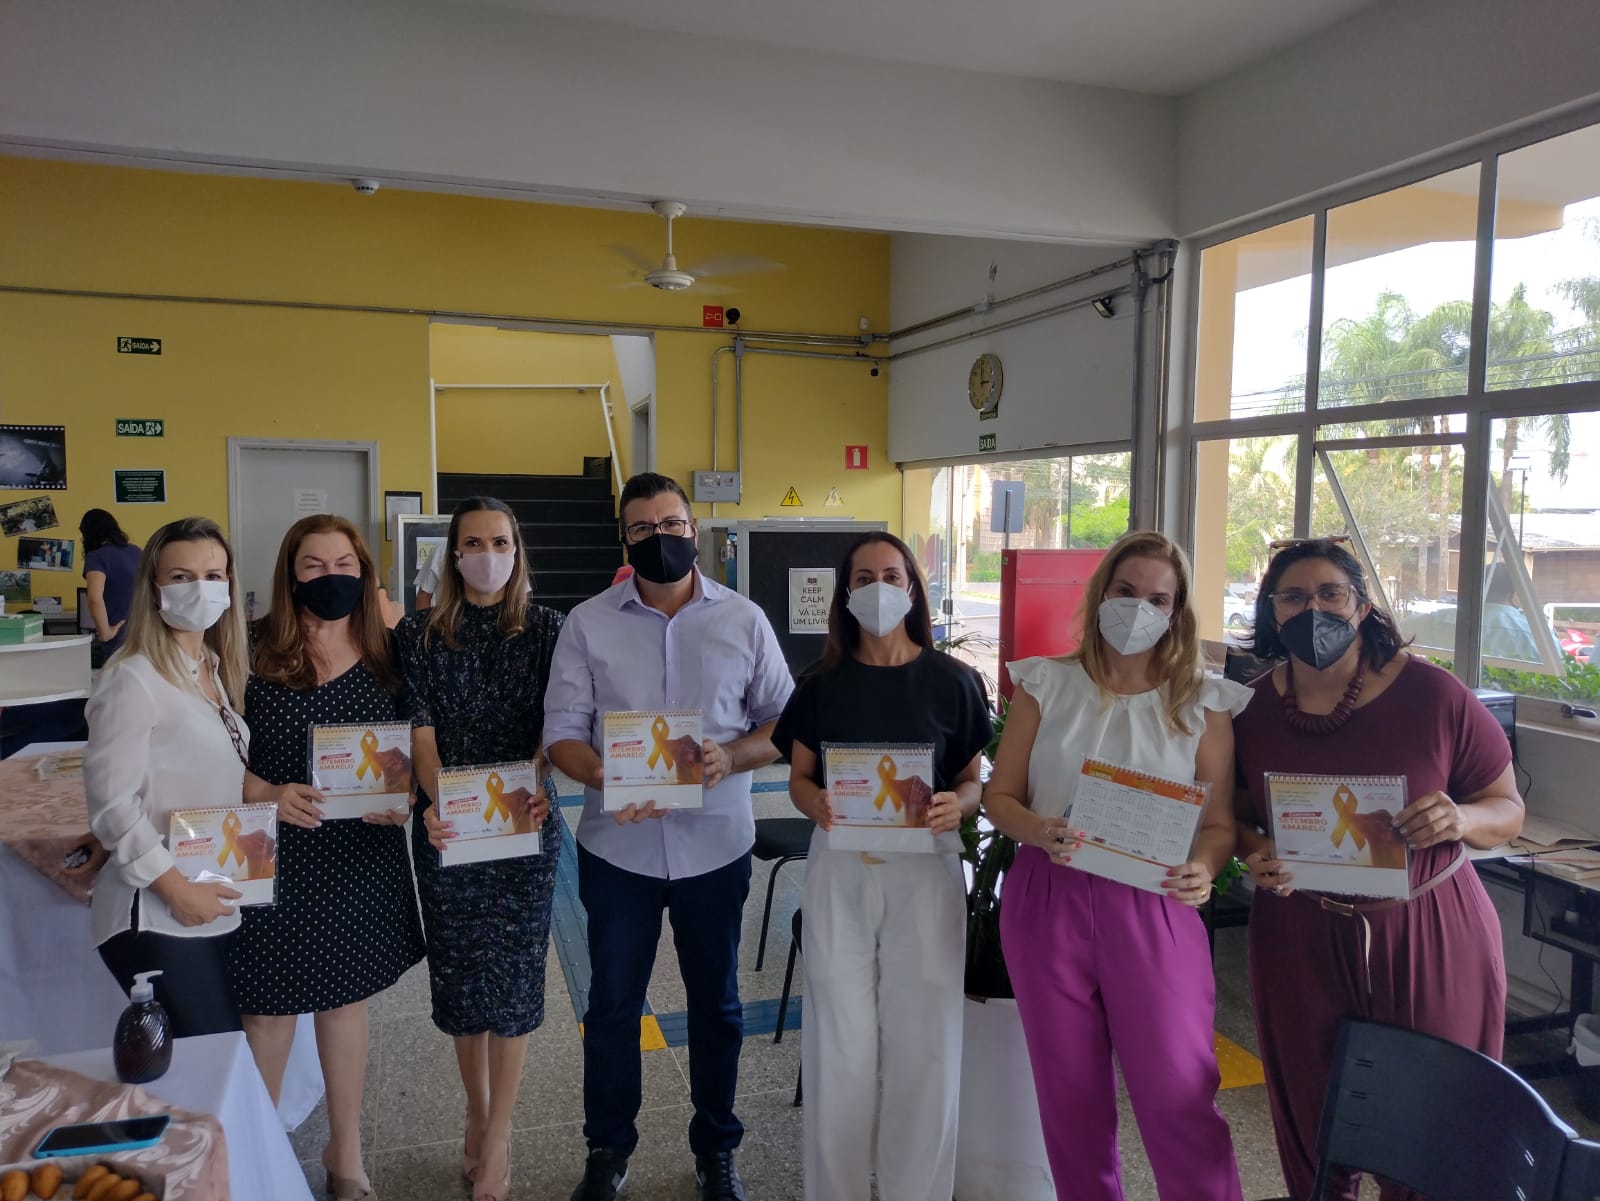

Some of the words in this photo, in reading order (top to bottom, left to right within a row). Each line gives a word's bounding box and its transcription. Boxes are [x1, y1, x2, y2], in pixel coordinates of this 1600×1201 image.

[118, 421, 144, 434] SAÍDA
[799, 608, 810, 616] VÁ
[1281, 824, 1326, 832] AMARELO
